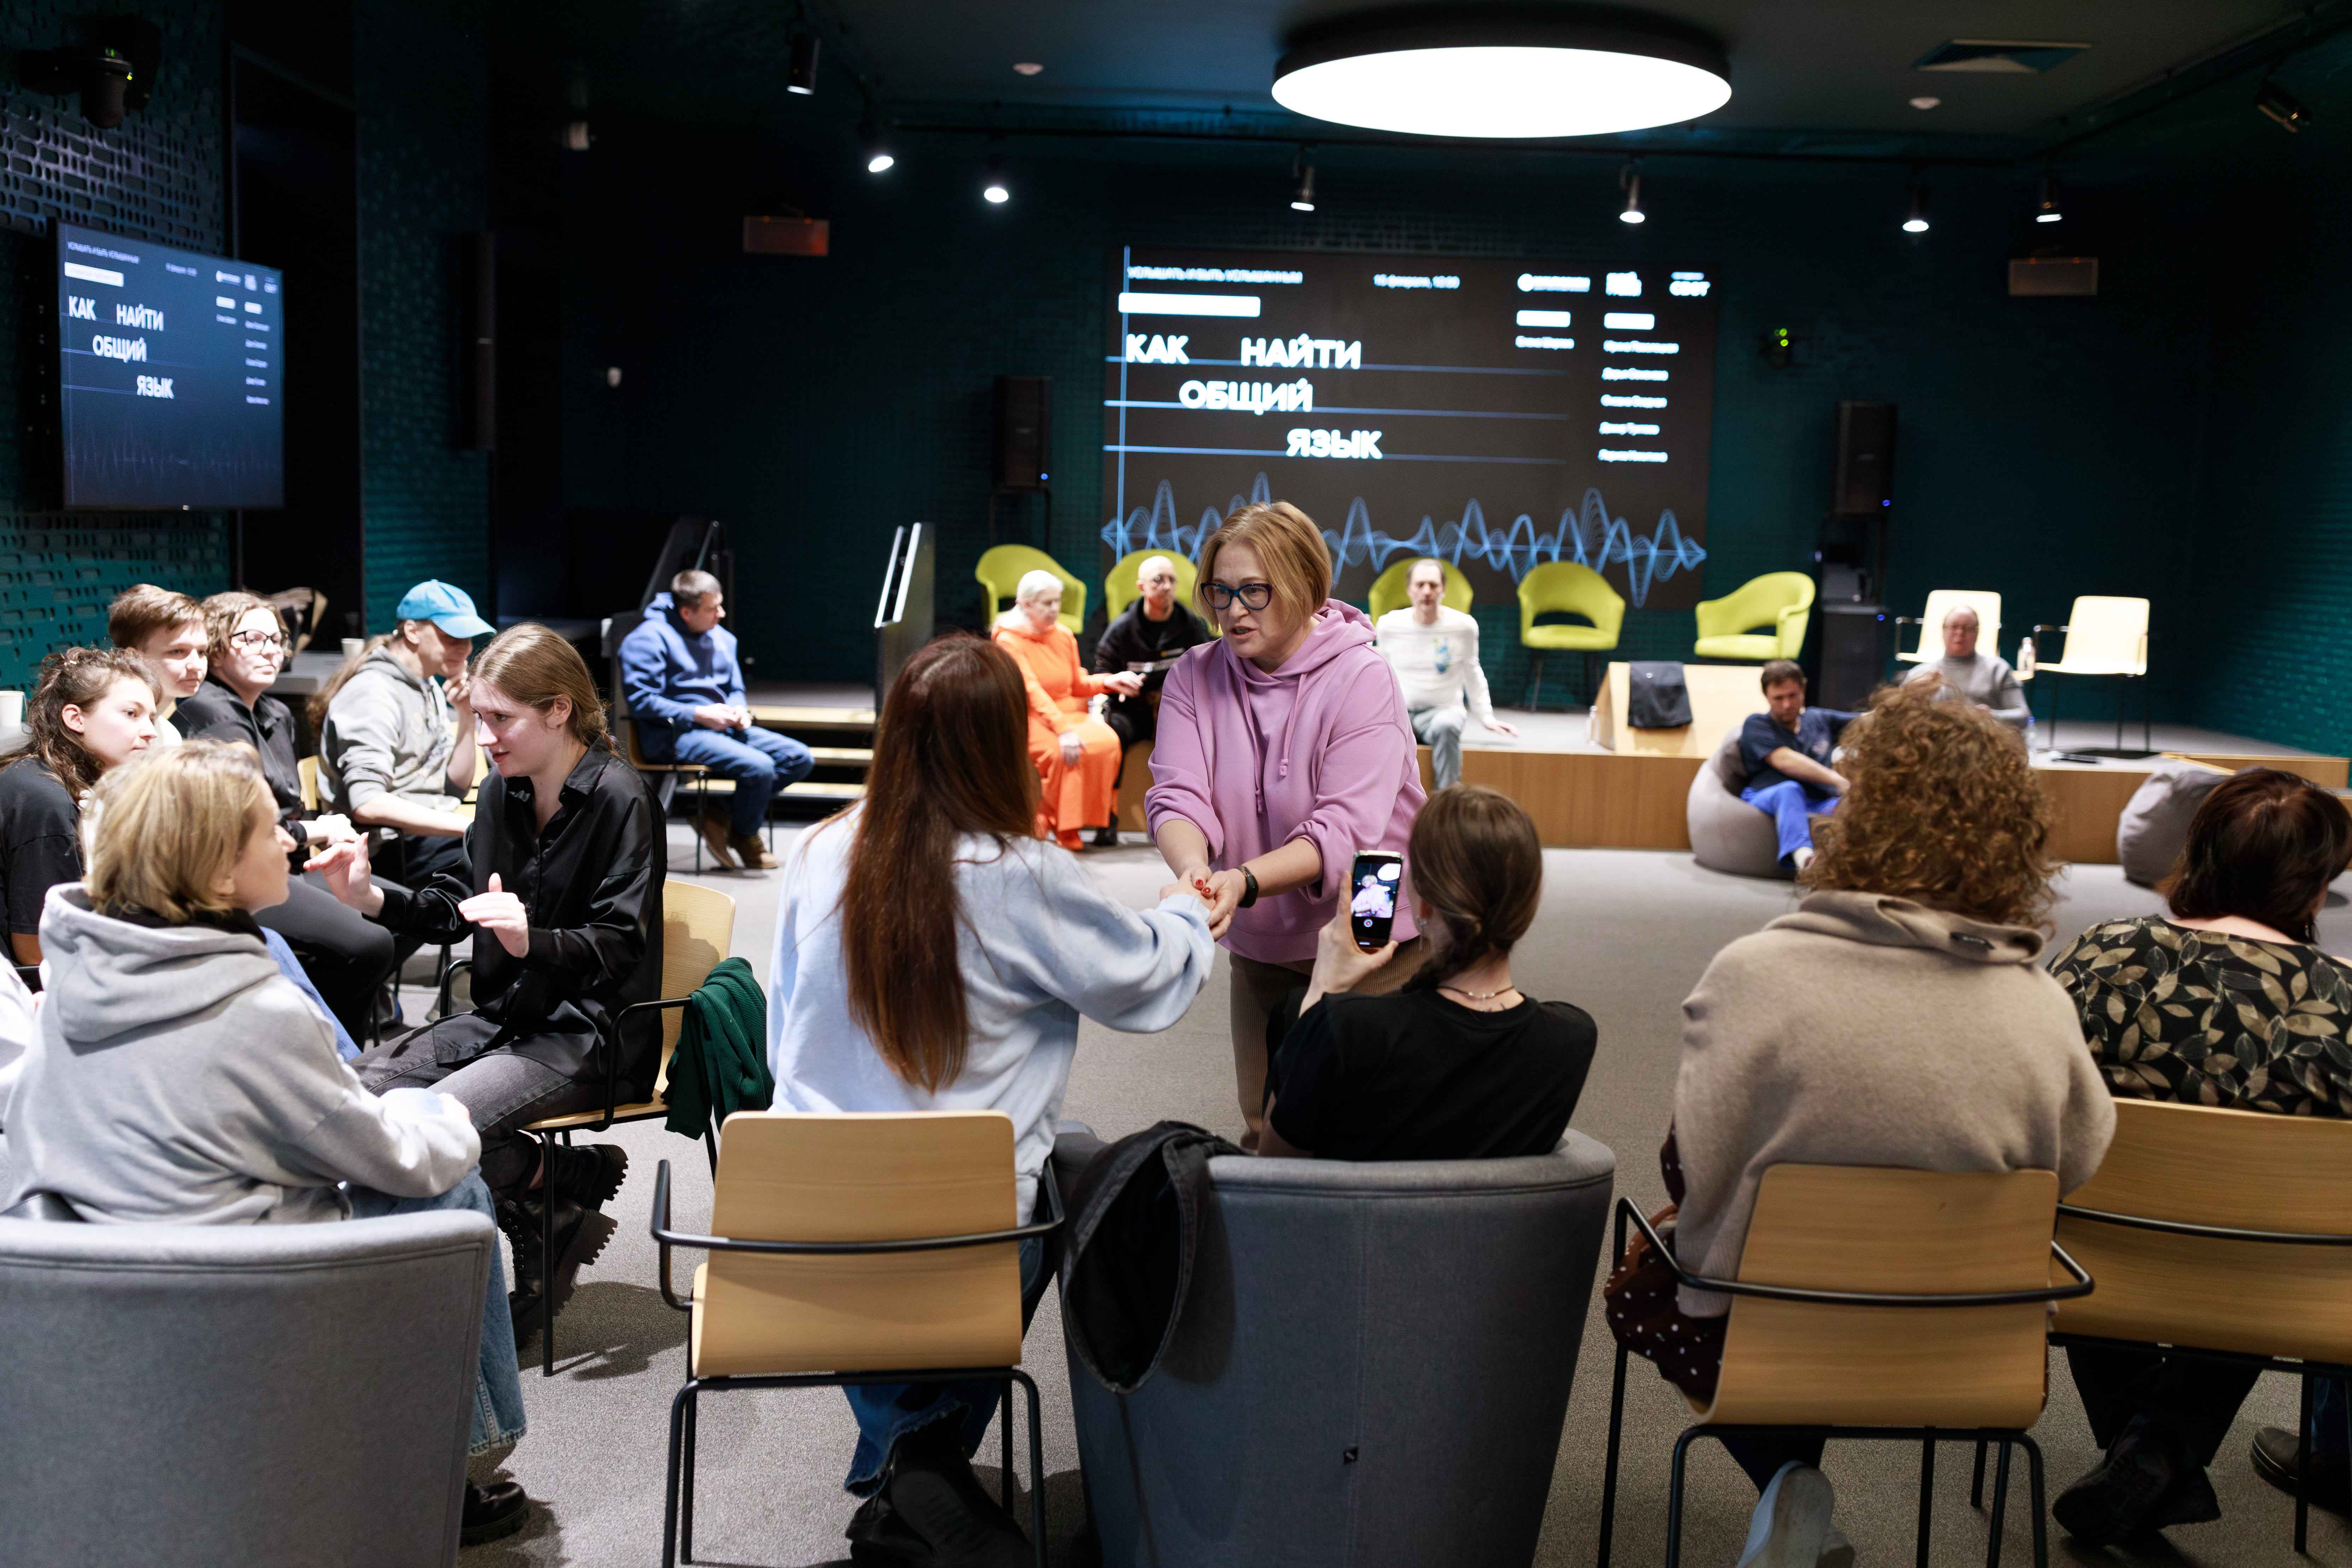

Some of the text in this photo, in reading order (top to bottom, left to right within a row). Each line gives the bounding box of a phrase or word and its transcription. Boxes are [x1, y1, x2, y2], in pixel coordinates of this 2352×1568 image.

[69, 296, 163, 331] КАК НАЙТИ
[93, 335, 147, 363] ОБЩИЙ
[1126, 334, 1361, 369] КАК НАЙТИ
[137, 375, 174, 398] ЯЗЫК
[1179, 378, 1313, 415] ОБЩИЙ
[1286, 429, 1382, 459] ЯЗЫК
